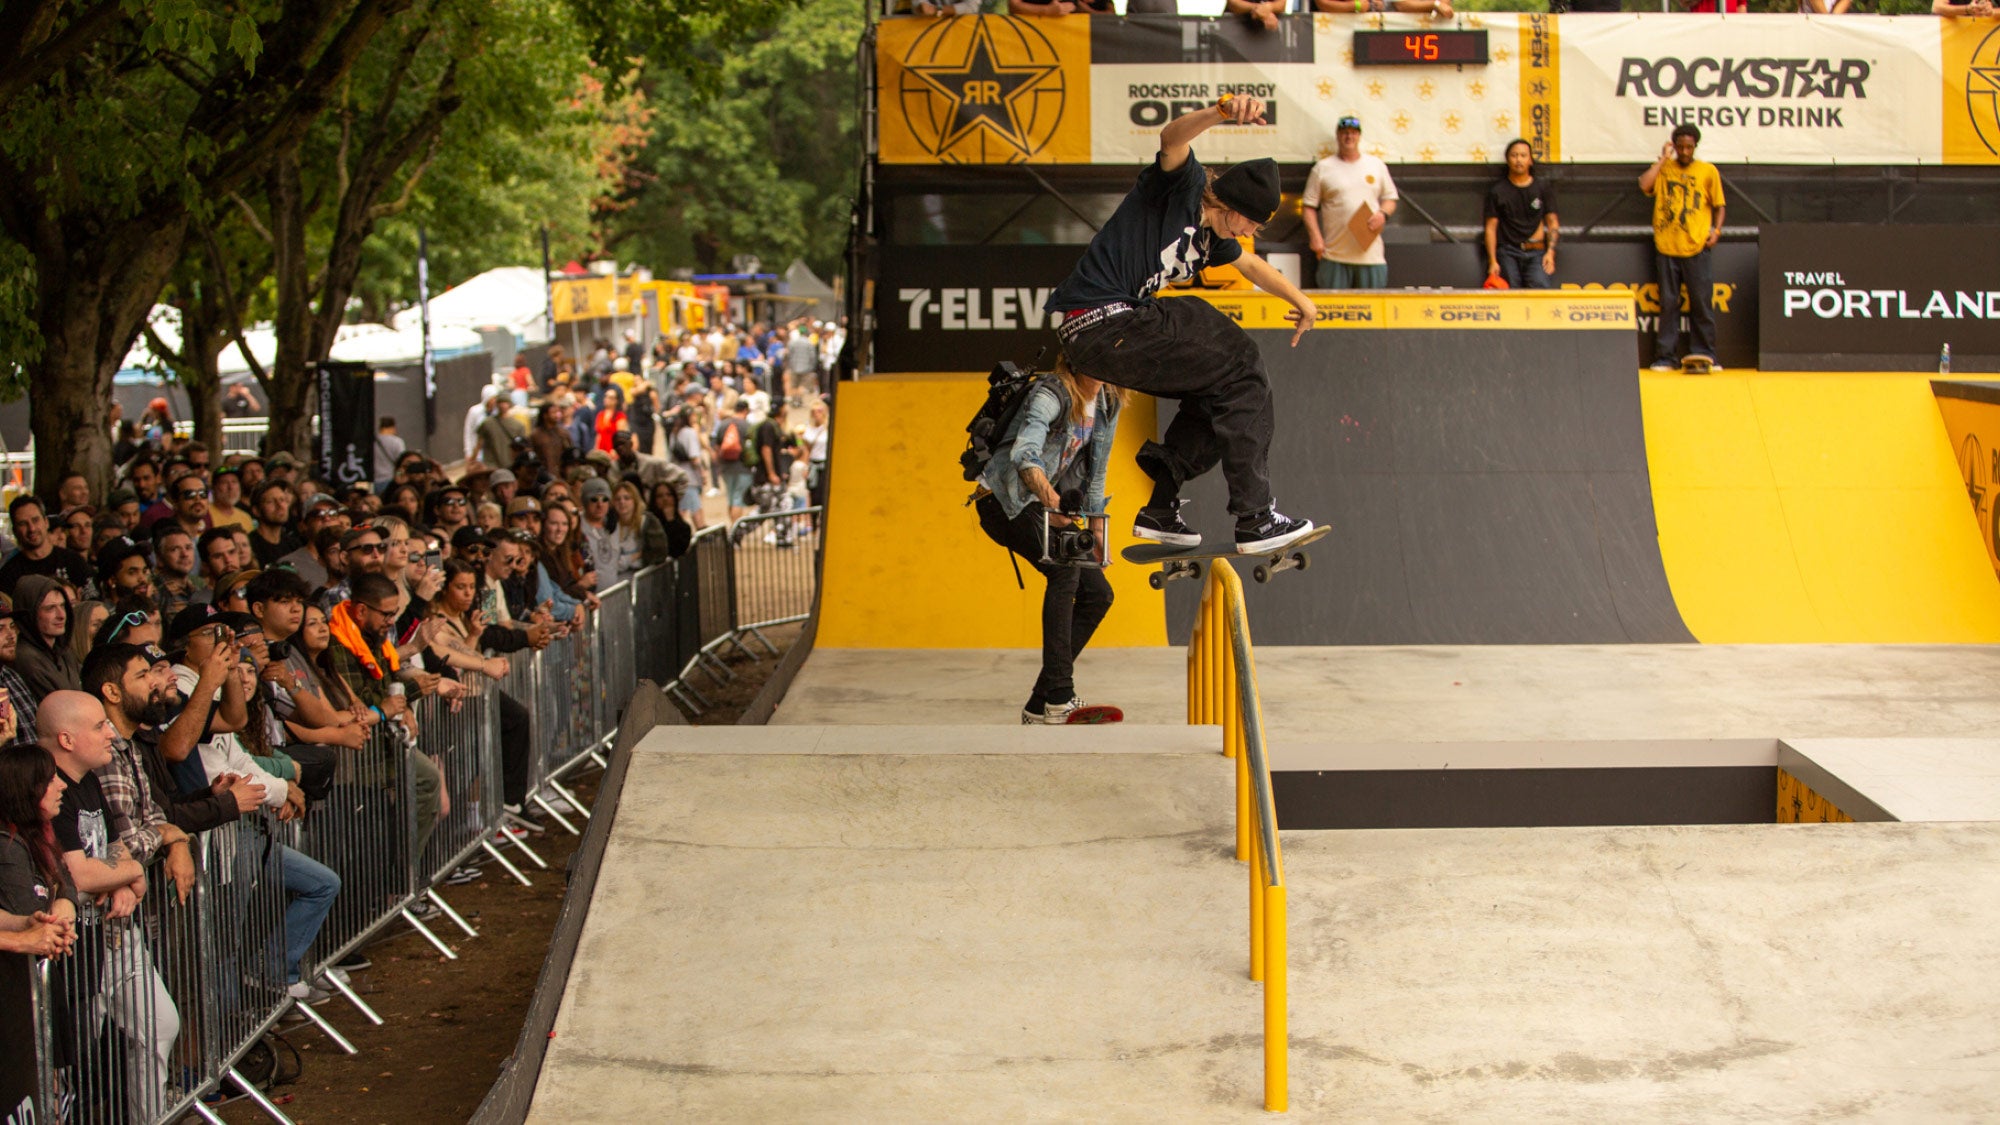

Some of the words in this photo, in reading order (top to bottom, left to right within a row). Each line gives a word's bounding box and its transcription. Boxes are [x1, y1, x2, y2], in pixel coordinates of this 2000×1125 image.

[1405, 34, 1439, 60] 45
[1614, 57, 1870, 98] ROCKSTAR
[1129, 84, 1209, 97] ROCKSTAR
[1217, 83, 1276, 97] ENERGY
[1643, 107, 1750, 126] ENERGY
[1758, 107, 1844, 127] DRINK
[1784, 272, 1846, 285] TRAVEL
[1440, 311, 1500, 321] OPEN
[1569, 311, 1629, 321] OPEN
